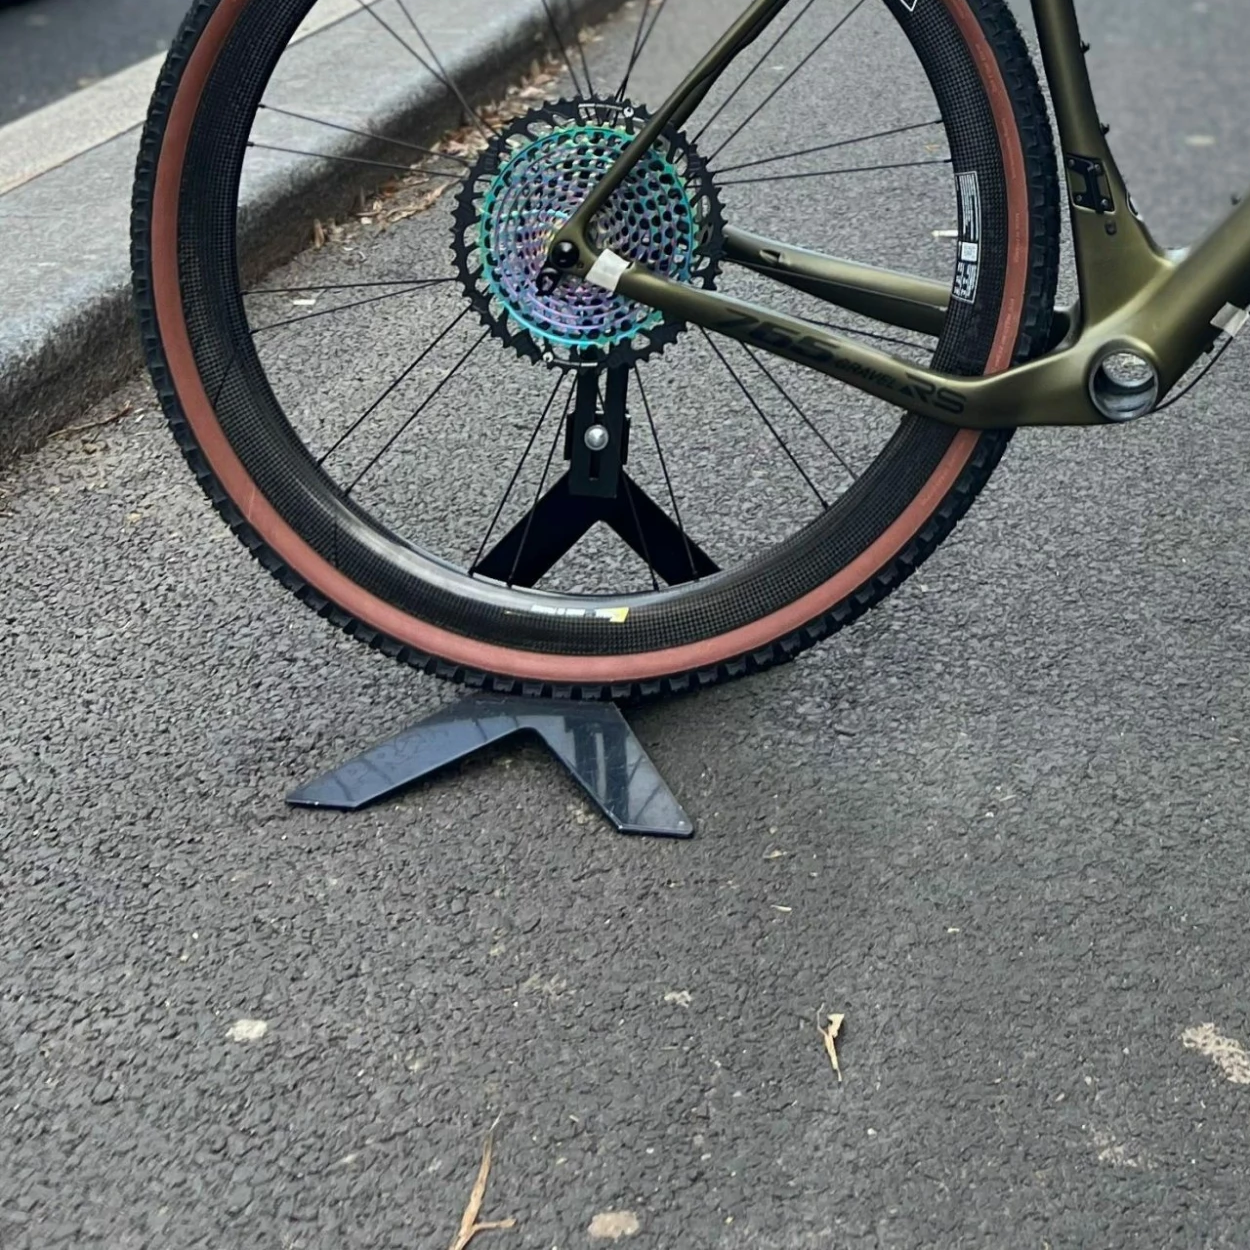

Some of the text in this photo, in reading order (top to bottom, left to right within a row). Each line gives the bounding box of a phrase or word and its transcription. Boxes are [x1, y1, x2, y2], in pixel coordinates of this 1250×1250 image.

[716, 307, 967, 414] 765 GRAVEL RS
